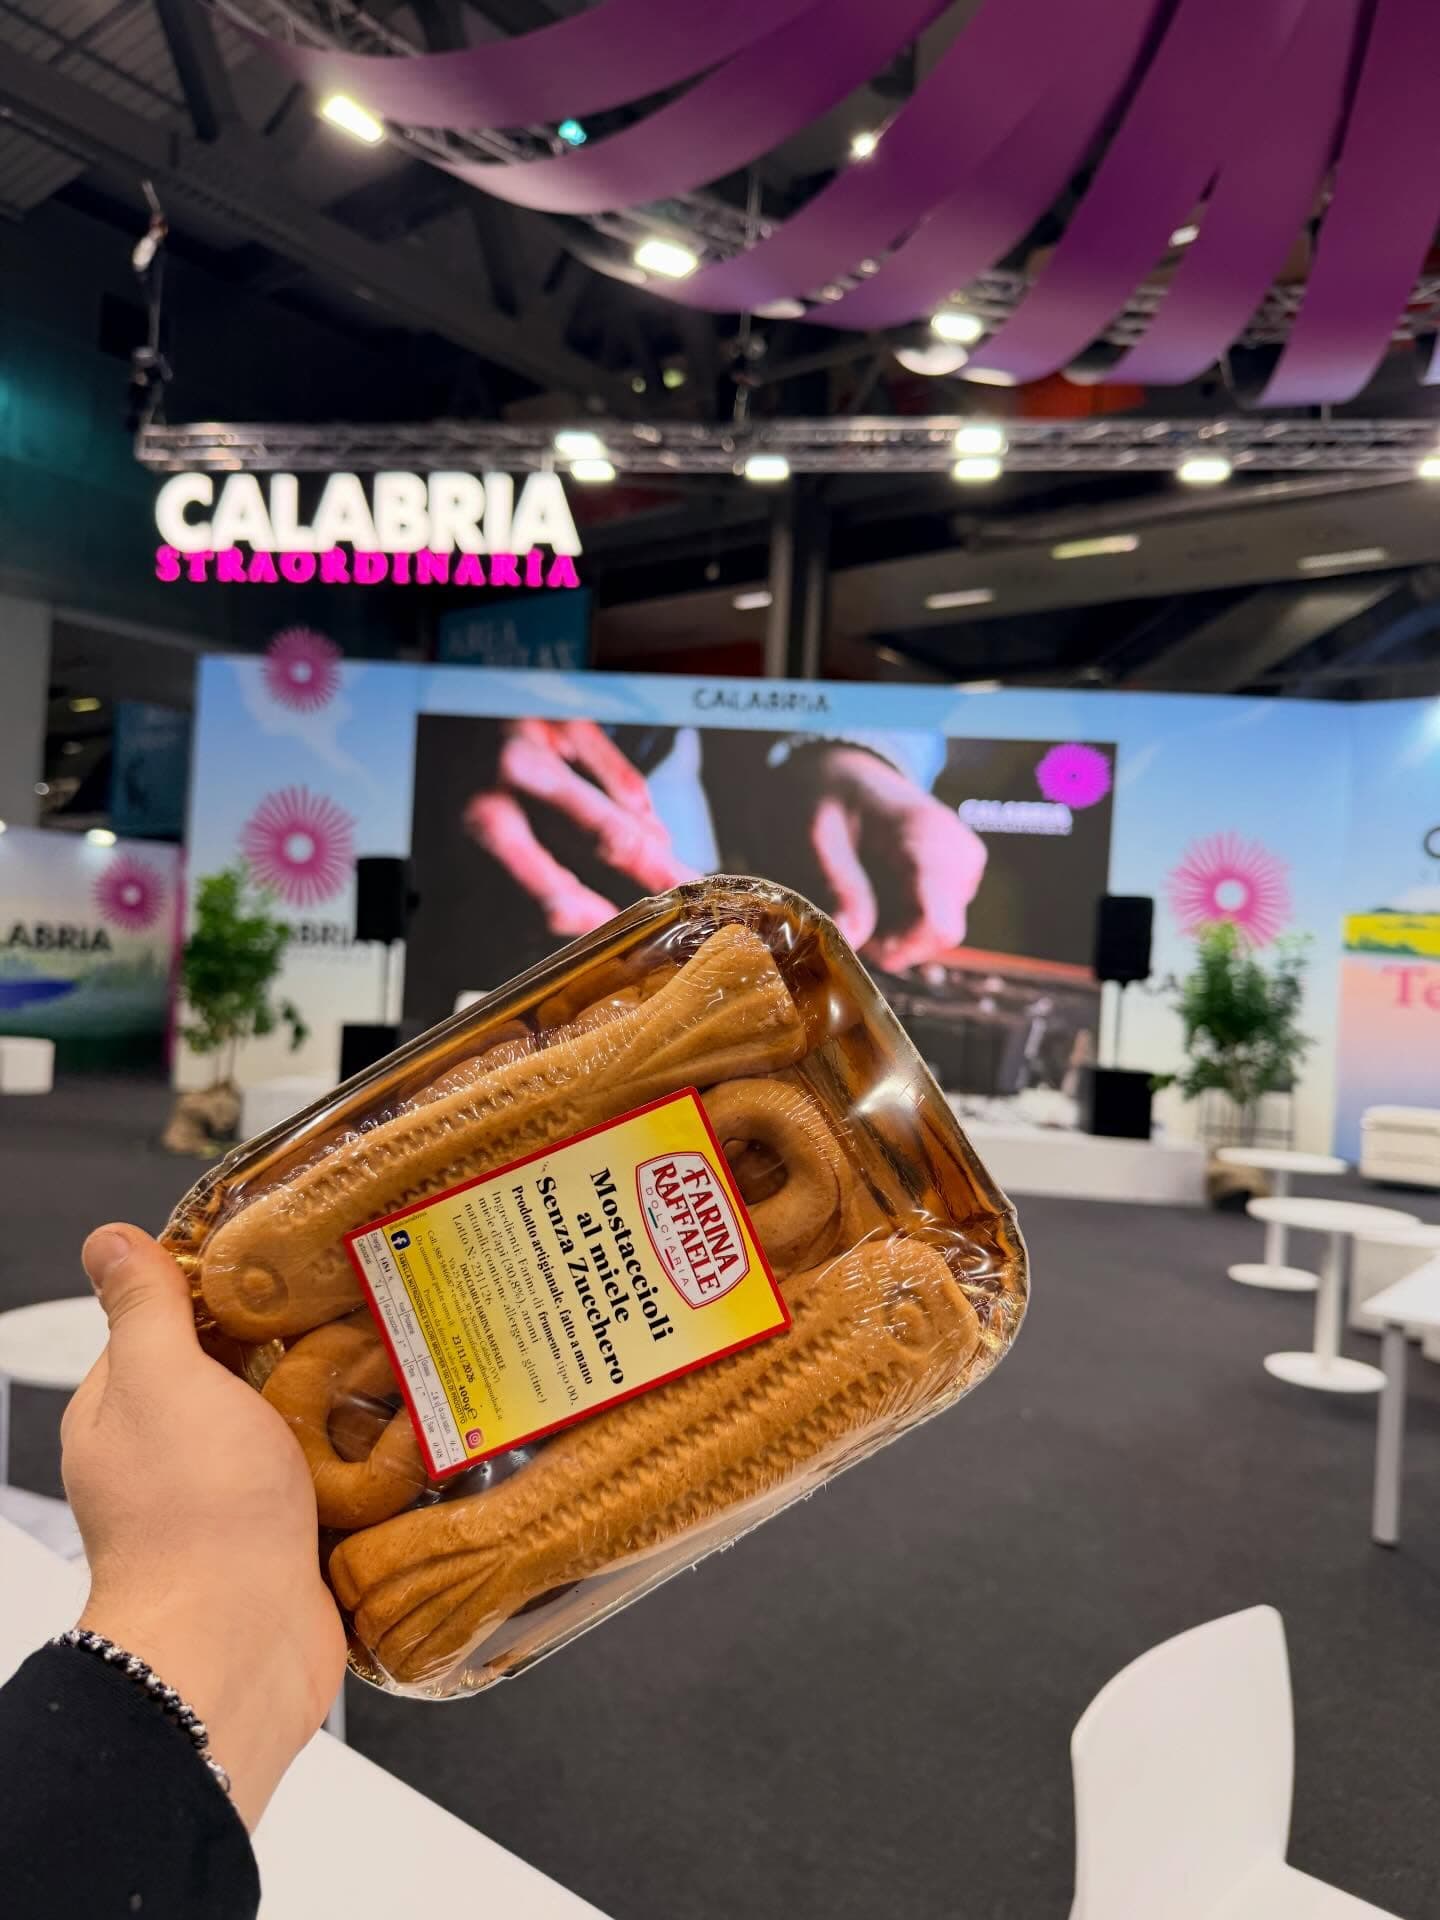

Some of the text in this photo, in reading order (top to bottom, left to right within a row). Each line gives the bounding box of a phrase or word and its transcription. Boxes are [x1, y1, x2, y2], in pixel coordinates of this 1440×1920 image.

[155, 472, 582, 555] CALABRIA
[154, 545, 582, 588] STRAORDINARIA
[691, 687, 832, 713] CALABRIA
[0, 920, 113, 951] ABRIA
[451, 1213, 472, 1246] Lotto
[489, 1189, 525, 1258] Ingredienti:
[510, 1184, 541, 1240] Prodotto
[644, 1184, 691, 1288] DOLCIARIA
[648, 1160, 722, 1298] RAFFAELE
[678, 1162, 743, 1275] FARINA
[476, 1195, 497, 1229] miele
[487, 1227, 509, 1259] d'api
[519, 1307, 542, 1345] aromi
[516, 1257, 538, 1296] Farina
[534, 1173, 632, 1387] Senza Zucchero
[575, 1207, 636, 1325] al miele
[588, 1165, 675, 1343] Mostaccioli
[458, 1261, 507, 1372] DOLCIARIA FARINA RAFFAELE
[499, 1300, 531, 1358] allergeni:
[530, 1294, 545, 1310] di
[557, 1307, 579, 1340] fatto
[449, 1332, 477, 1384] 23/11/2026
[536, 1309, 564, 1361] frumento
[569, 1339, 579, 1349] a
[552, 1359, 572, 1386] tipo
[572, 1348, 594, 1386] mano
